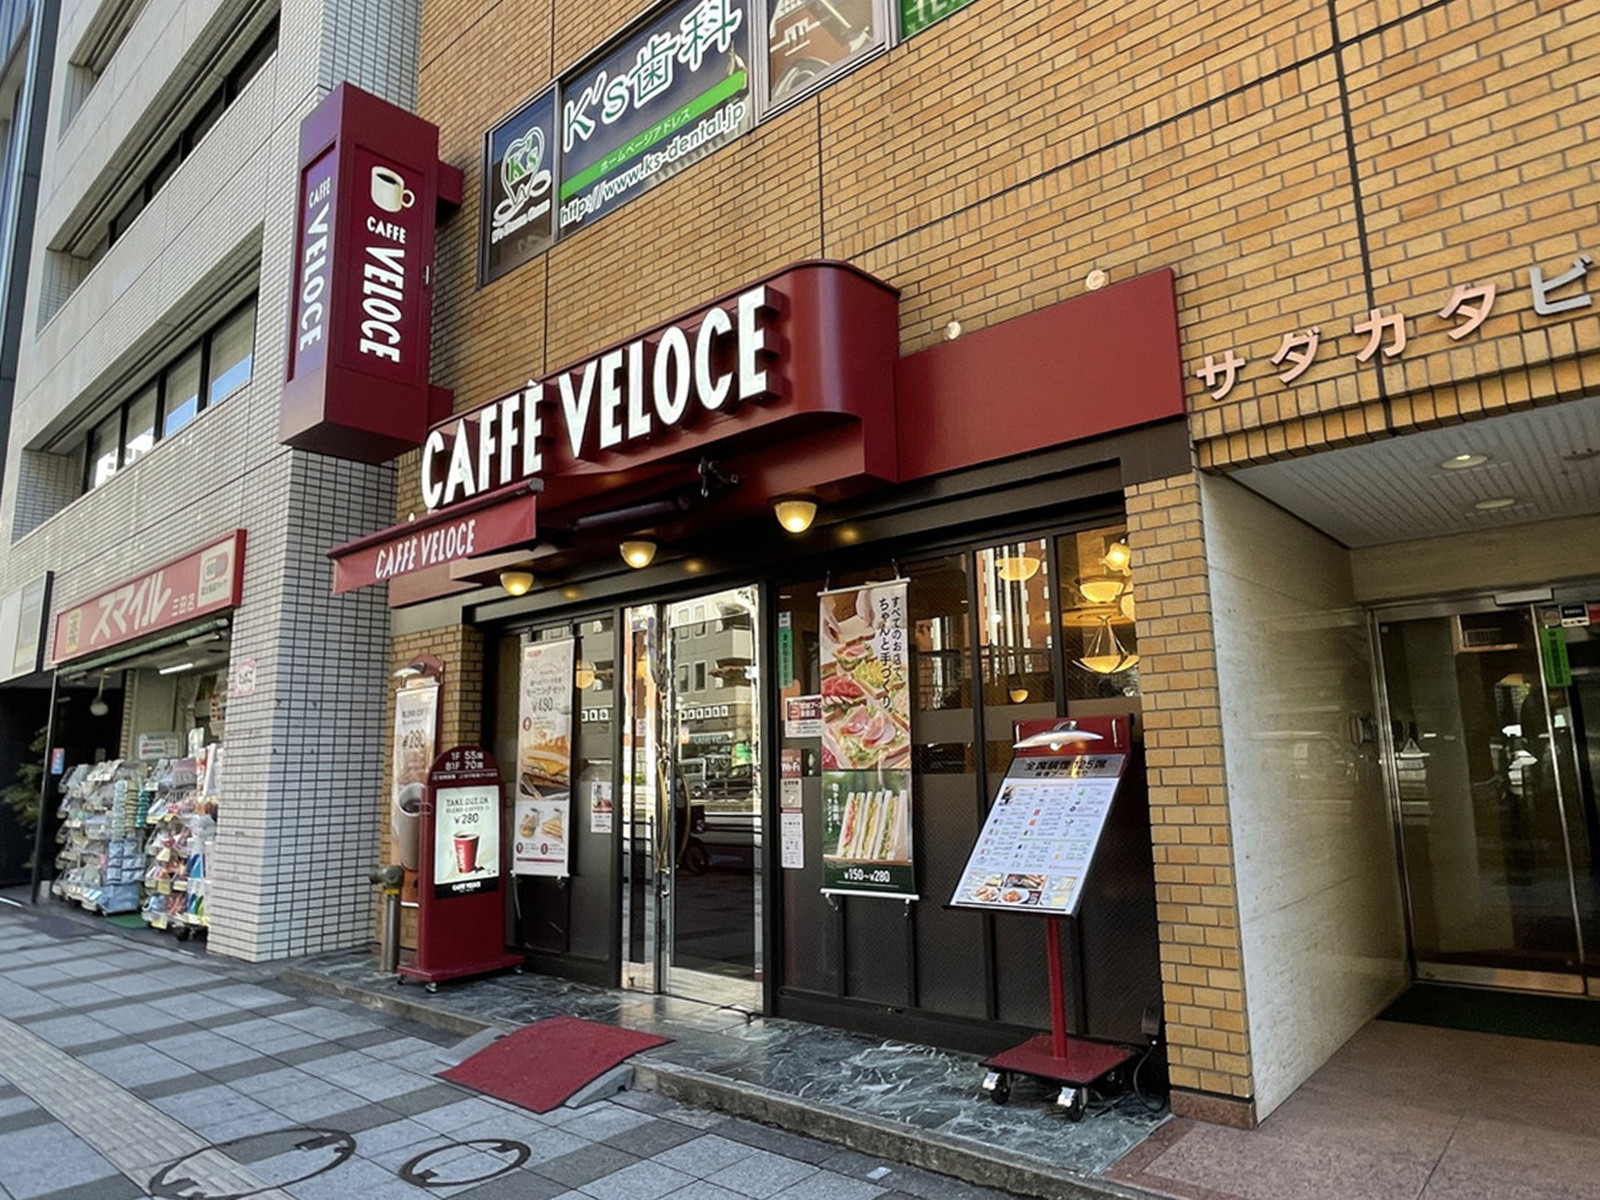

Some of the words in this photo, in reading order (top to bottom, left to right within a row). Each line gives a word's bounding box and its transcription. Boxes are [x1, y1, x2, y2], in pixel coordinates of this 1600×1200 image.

[300, 202, 330, 352] VELOCE
[359, 246, 406, 363] VELOCE
[1196, 255, 1592, 401] サダカタビ
[558, 285, 767, 459] VELOCE
[90, 568, 172, 645] スマイル
[421, 518, 476, 567] VELOCE
